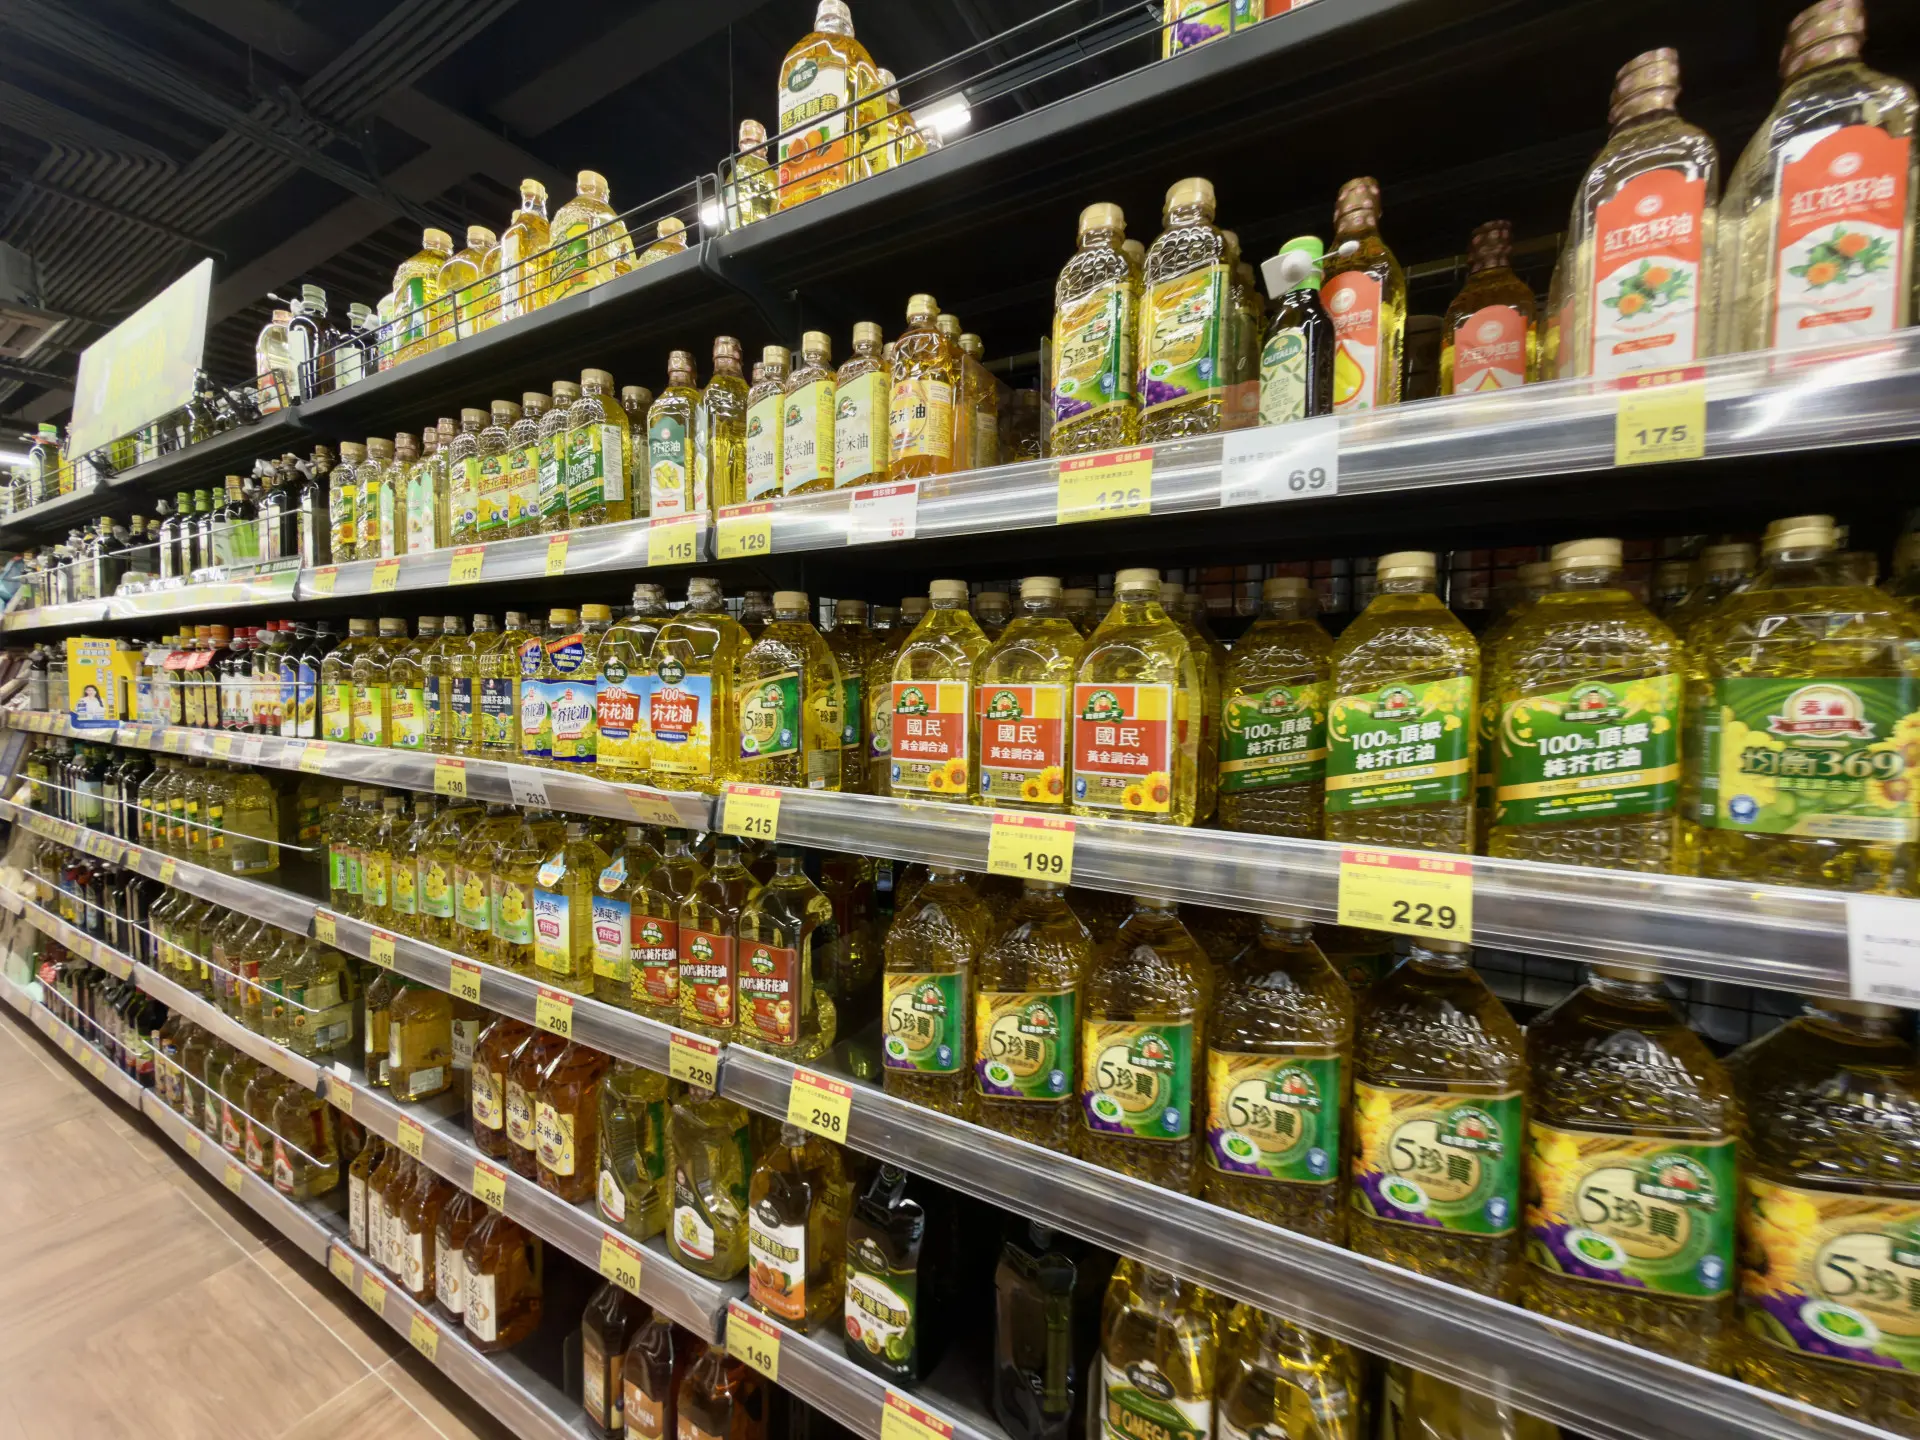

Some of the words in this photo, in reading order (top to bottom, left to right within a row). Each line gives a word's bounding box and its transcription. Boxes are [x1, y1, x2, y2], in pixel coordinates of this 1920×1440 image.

[1789, 176, 1896, 216] 紅花籽油
[1604, 213, 1693, 251] 紅花籽油
[1635, 425, 1688, 446] 175
[1288, 467, 1327, 492] 69
[1096, 488, 1142, 511] 126
[668, 543, 692, 558] 115
[740, 534, 765, 550] 129
[462, 568, 478, 579] 115
[606, 687, 628, 700] 100%
[661, 688, 686, 701] 100%
[557, 704, 589, 722] 芥花油
[599, 702, 634, 720] 芥花油
[652, 704, 692, 723] 芥花油
[1798, 699, 1846, 716] 泰山
[745, 711, 774, 732] 5珍寶
[906, 718, 942, 738] 國民
[1243, 716, 1312, 740] 100%頂級
[997, 724, 1038, 744] 國民
[1095, 726, 1140, 748] 國民
[1351, 721, 1442, 751] 100%頂級
[1537, 723, 1649, 756] 100%頂級
[900, 739, 948, 754] 黃金調合油
[990, 746, 1045, 761] 黃金調合油
[1246, 734, 1307, 756] 純芥花油
[1087, 750, 1149, 766] 黃金調合油
[1355, 743, 1436, 770] 純芥花油
[1543, 747, 1642, 778] 純芥花油
[448, 780, 463, 792] 130
[526, 793, 546, 805] 233
[745, 817, 771, 833] 215
[1023, 852, 1064, 873] 199
[1392, 900, 1456, 930] 229
[680, 964, 728, 978] 100%純芥花油
[462, 985, 477, 998] 289
[739, 977, 789, 993] 100%純芥花油
[550, 1016, 568, 1032] 209
[891, 1008, 931, 1038] 5珍寶
[993, 1031, 1041, 1063] 5珍寶
[688, 1066, 713, 1085] 229
[1099, 1061, 1153, 1099] 5珍寶
[811, 1108, 841, 1132] 298
[1231, 1096, 1296, 1139] 5珍寶
[536, 1120, 563, 1146] 玄米油
[1394, 1138, 1473, 1186] 5珍寶
[485, 1189, 502, 1206] 285
[616, 1268, 637, 1290] 200
[745, 1346, 772, 1370] 149
